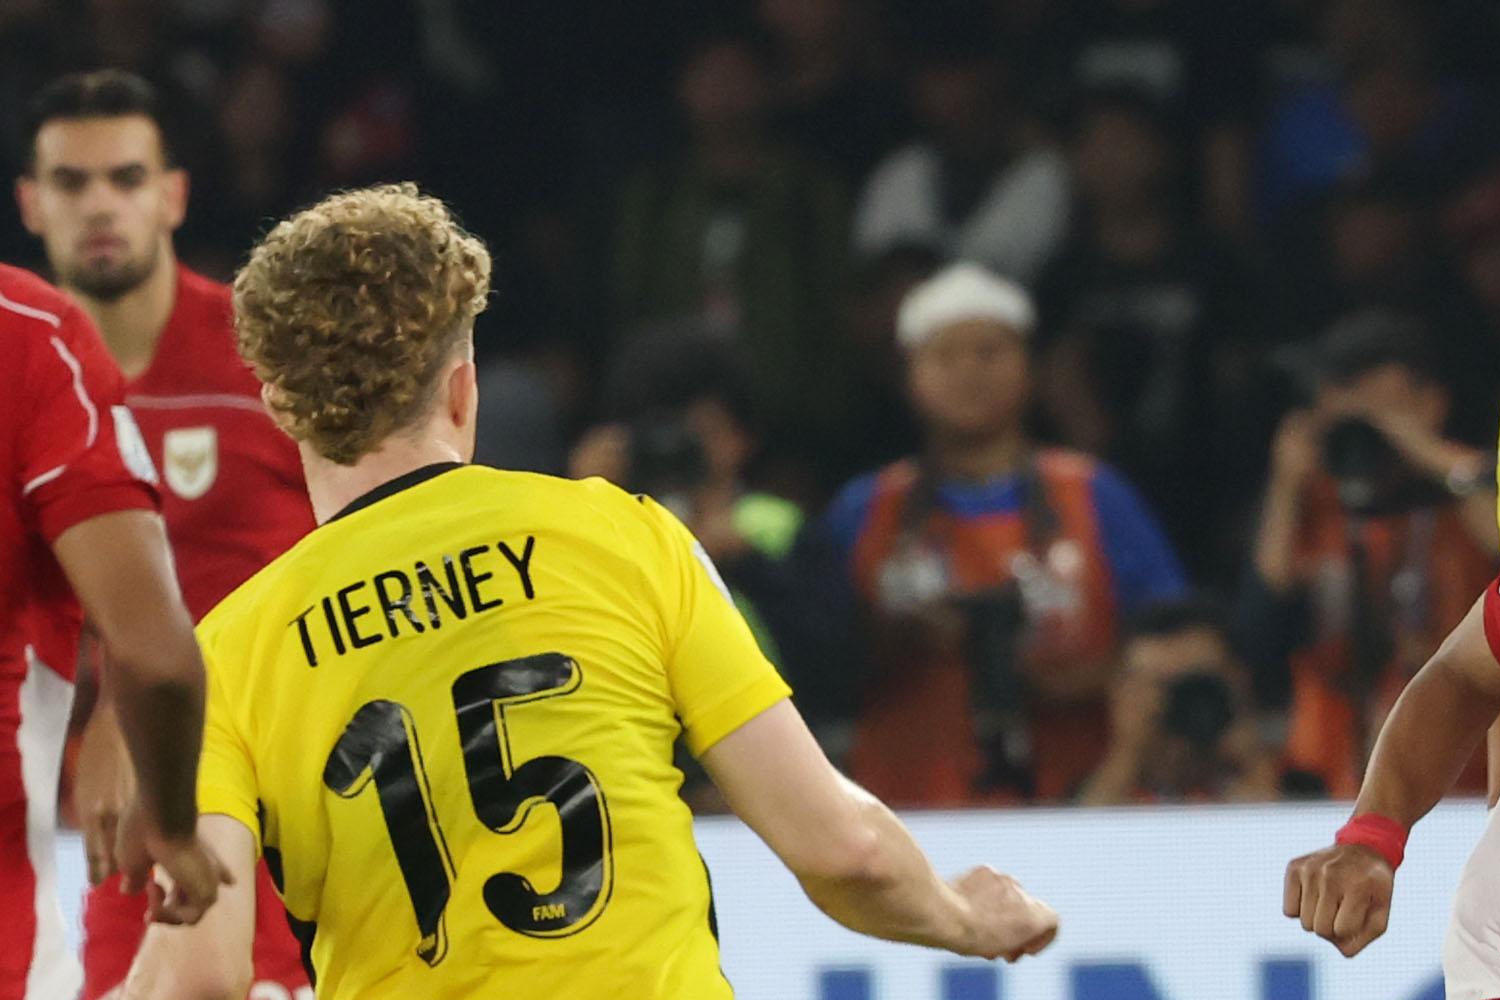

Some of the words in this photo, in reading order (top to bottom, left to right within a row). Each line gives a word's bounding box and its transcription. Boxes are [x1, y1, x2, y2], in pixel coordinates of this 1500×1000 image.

[289, 536, 537, 667] TIERNEY
[323, 652, 615, 968] 15
[532, 903, 566, 921] FAM
